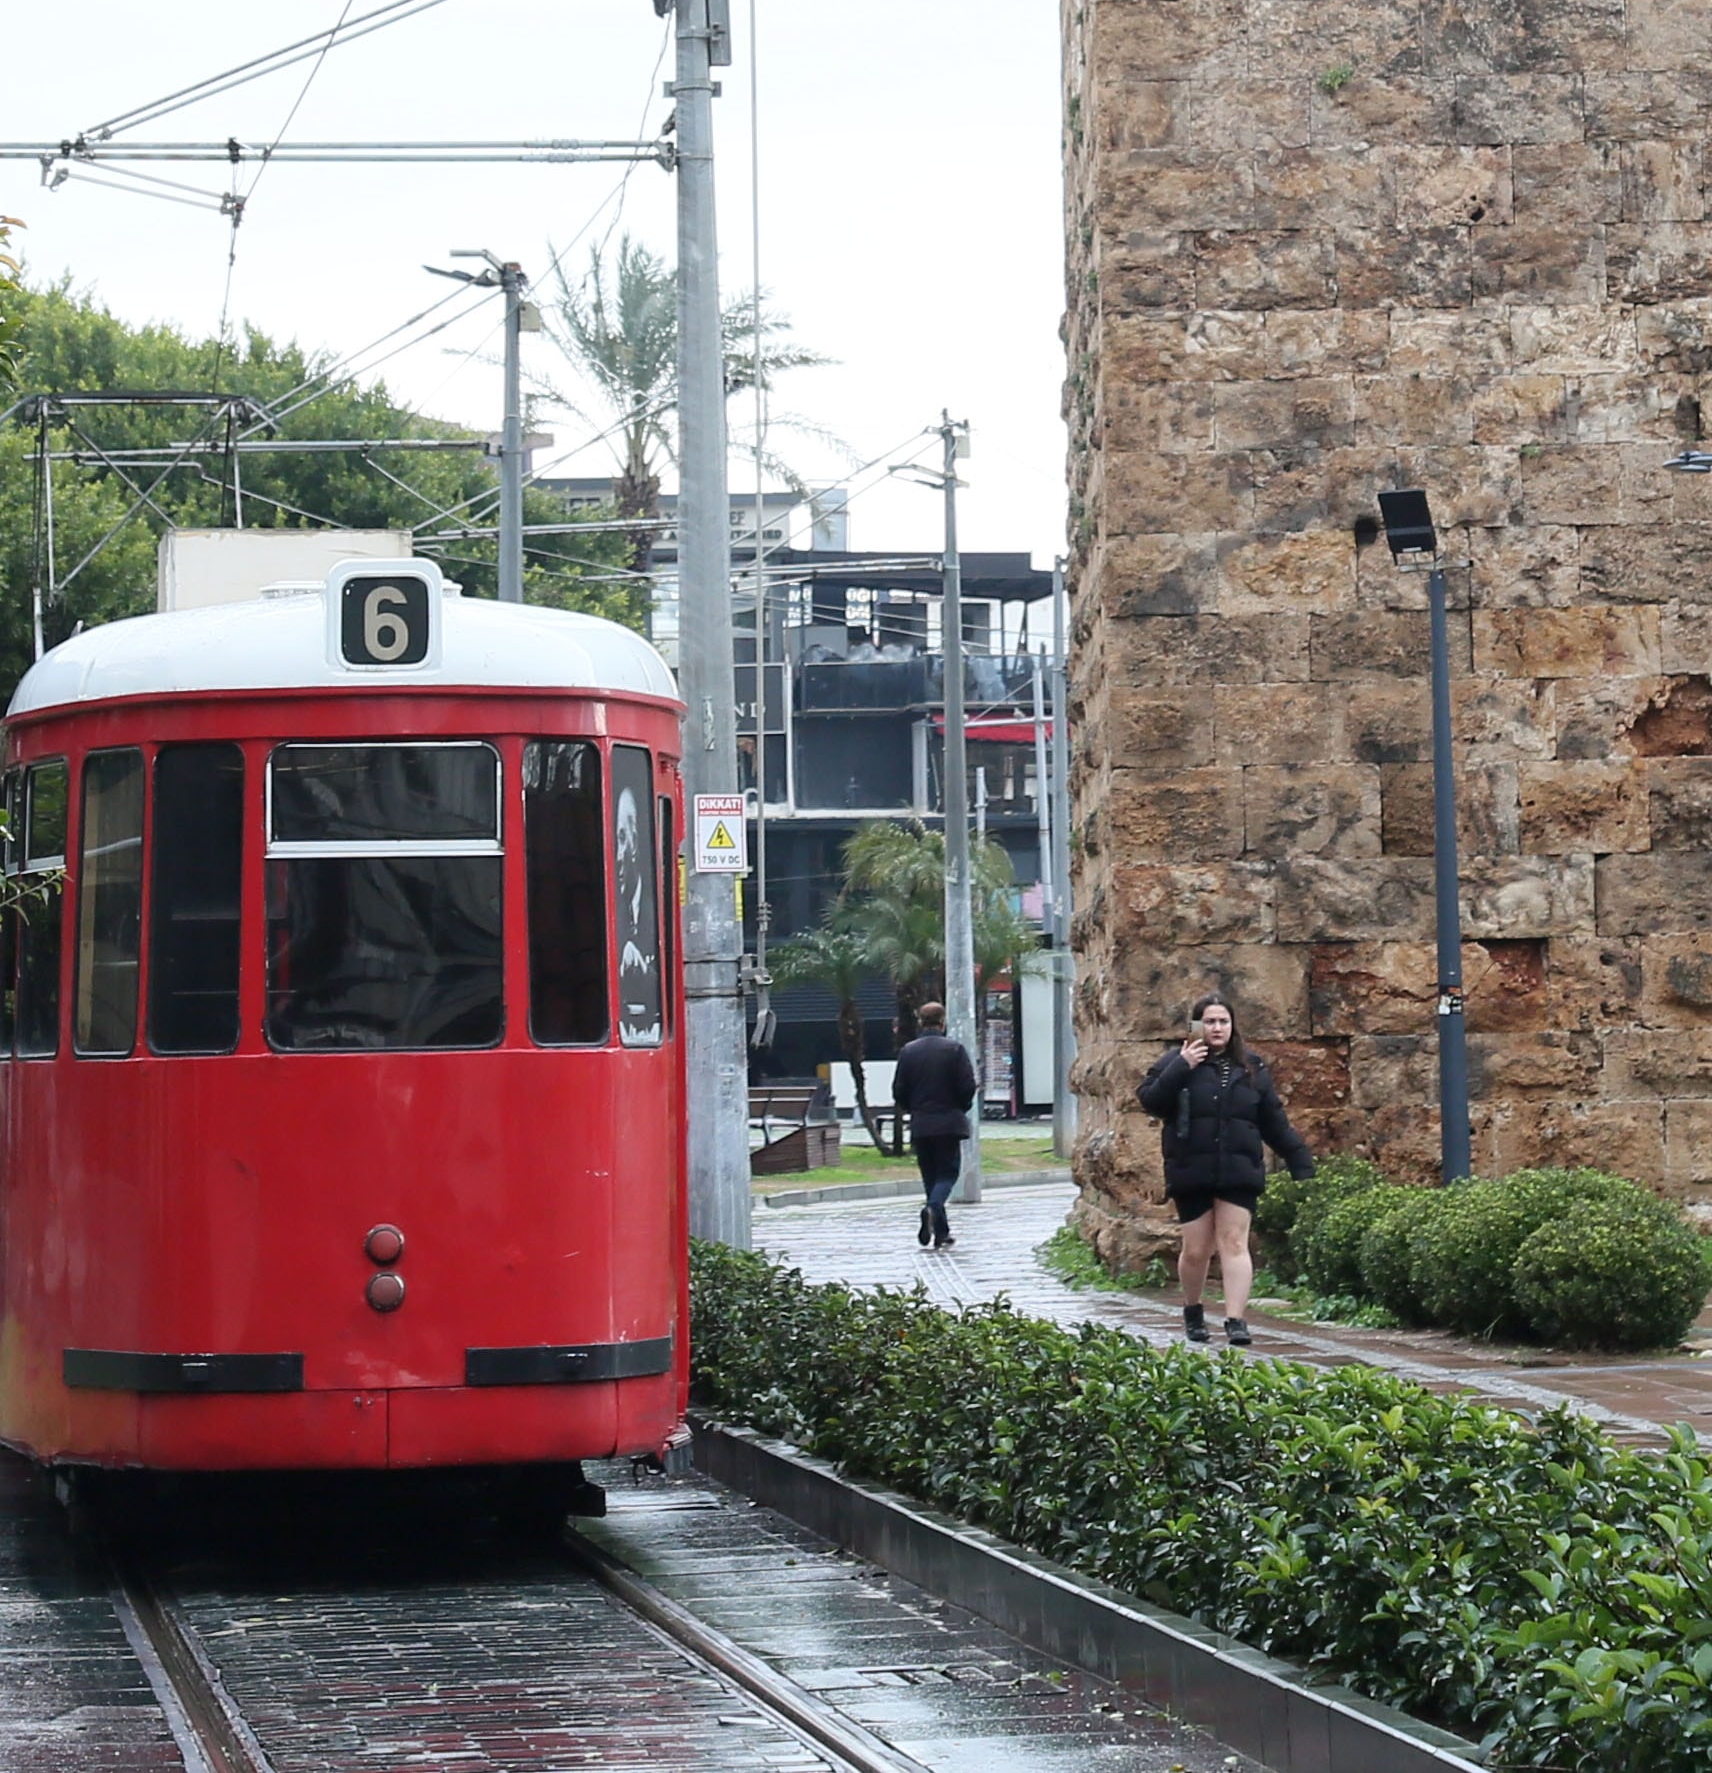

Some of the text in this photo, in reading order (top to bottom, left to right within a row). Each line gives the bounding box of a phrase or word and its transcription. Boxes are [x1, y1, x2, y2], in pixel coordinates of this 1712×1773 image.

[364, 585, 409, 661] 6
[702, 855, 740, 864] 750 V DC
